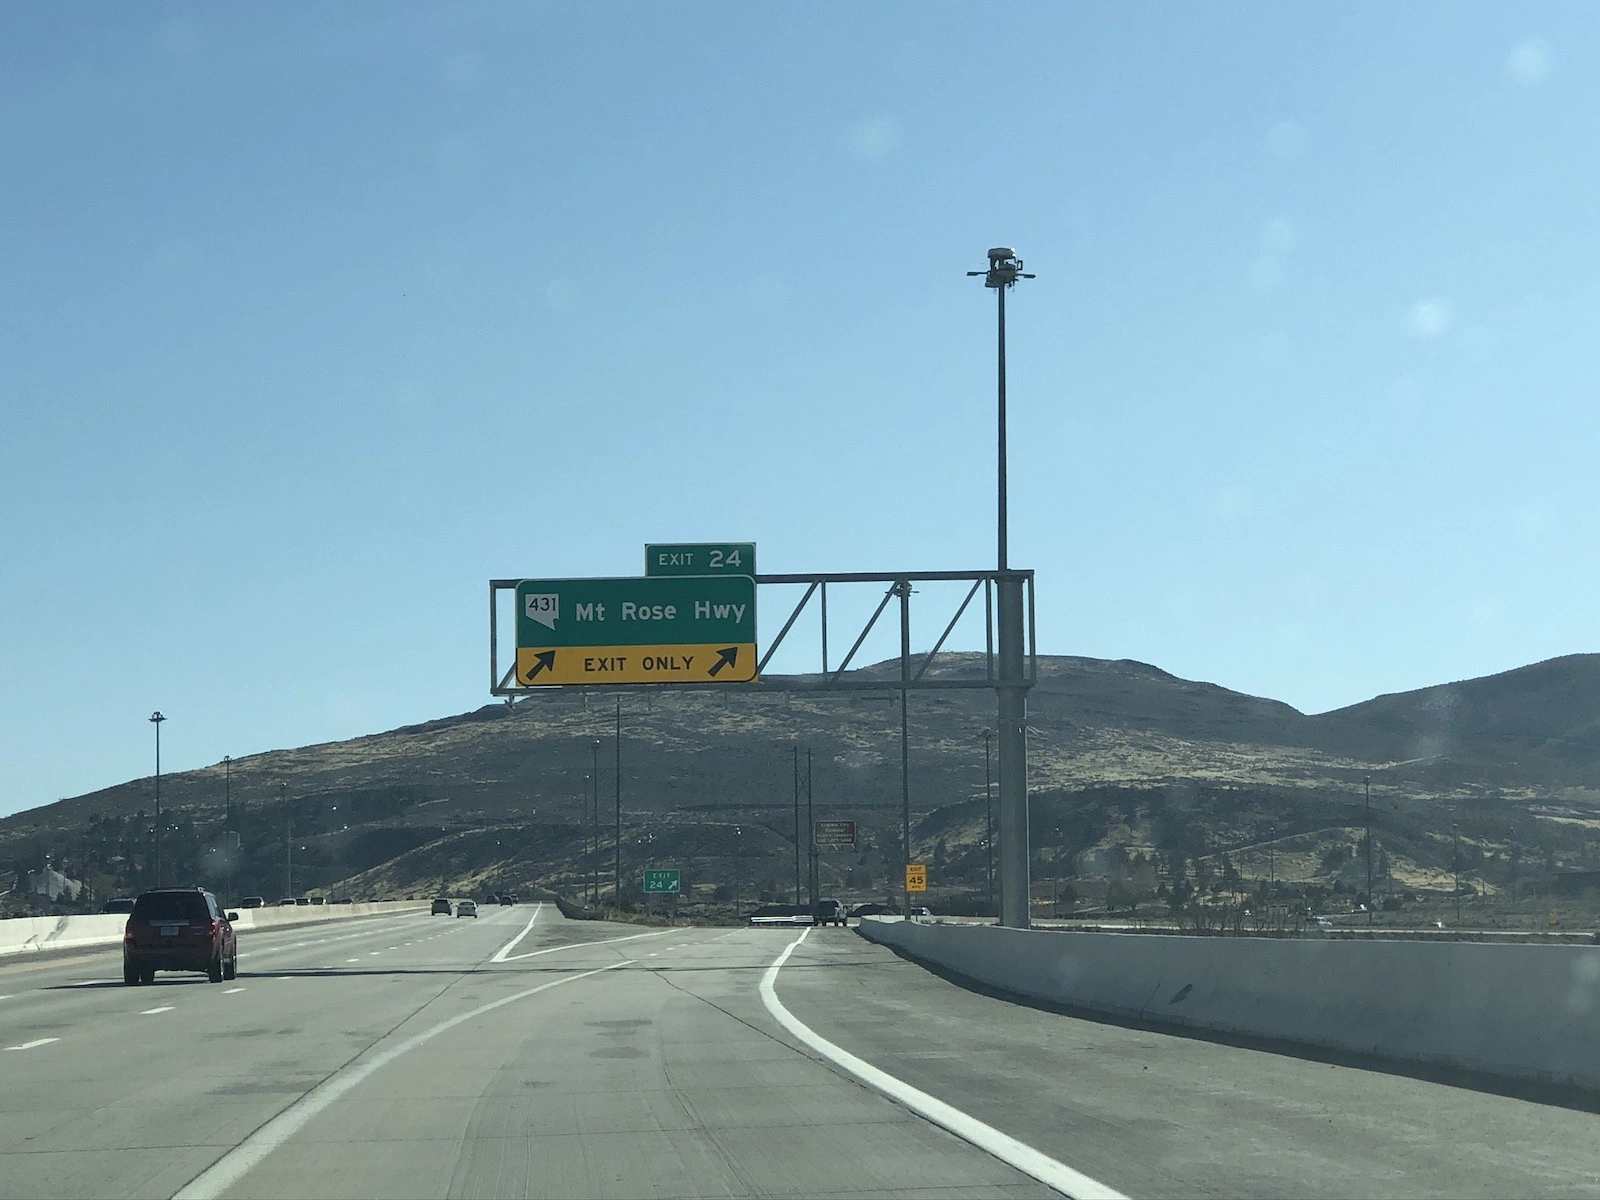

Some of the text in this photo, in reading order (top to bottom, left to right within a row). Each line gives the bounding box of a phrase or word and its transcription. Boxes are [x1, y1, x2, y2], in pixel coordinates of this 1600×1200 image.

[658, 550, 742, 568] EXIT 24
[528, 597, 557, 612] 431
[575, 600, 746, 624] Mt Rose Hwy
[584, 655, 694, 672] EXIT ONLY
[649, 880, 663, 889] 24
[909, 876, 924, 884] 45
